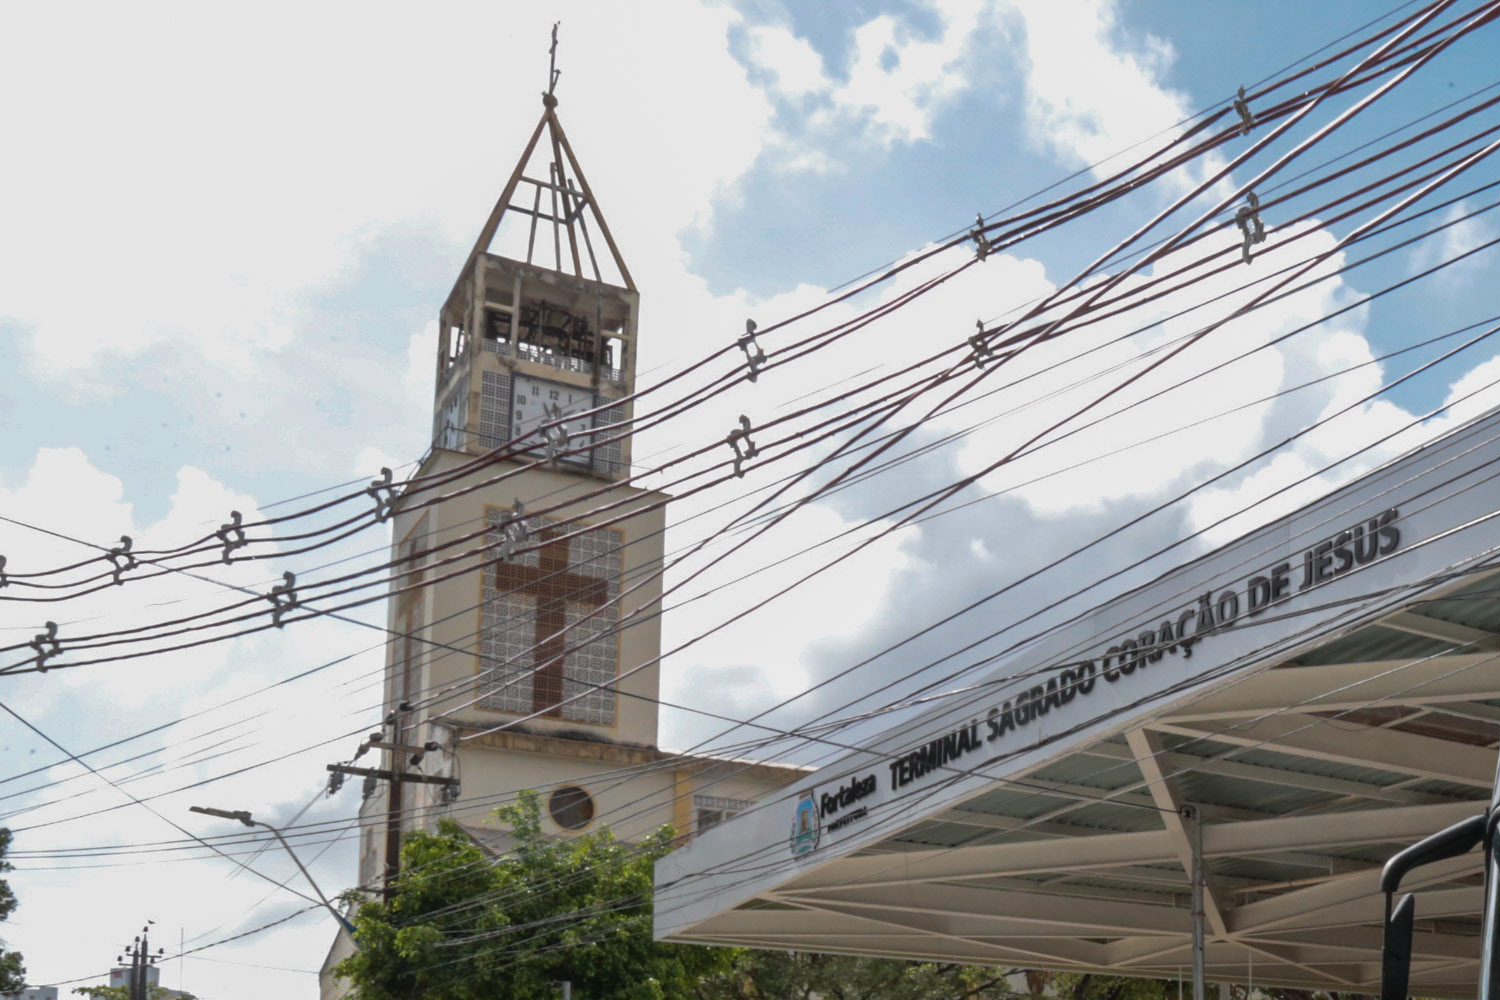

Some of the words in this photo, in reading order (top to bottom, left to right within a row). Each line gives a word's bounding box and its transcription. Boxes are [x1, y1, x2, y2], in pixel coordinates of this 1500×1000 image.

[889, 718, 982, 791] TERMINAL
[987, 659, 1095, 742] SAGRADO
[1102, 590, 1238, 683] CORAÇÃO
[1247, 561, 1291, 617] DE
[1299, 507, 1400, 591] JESUS
[821, 773, 876, 819] Fortaleza
